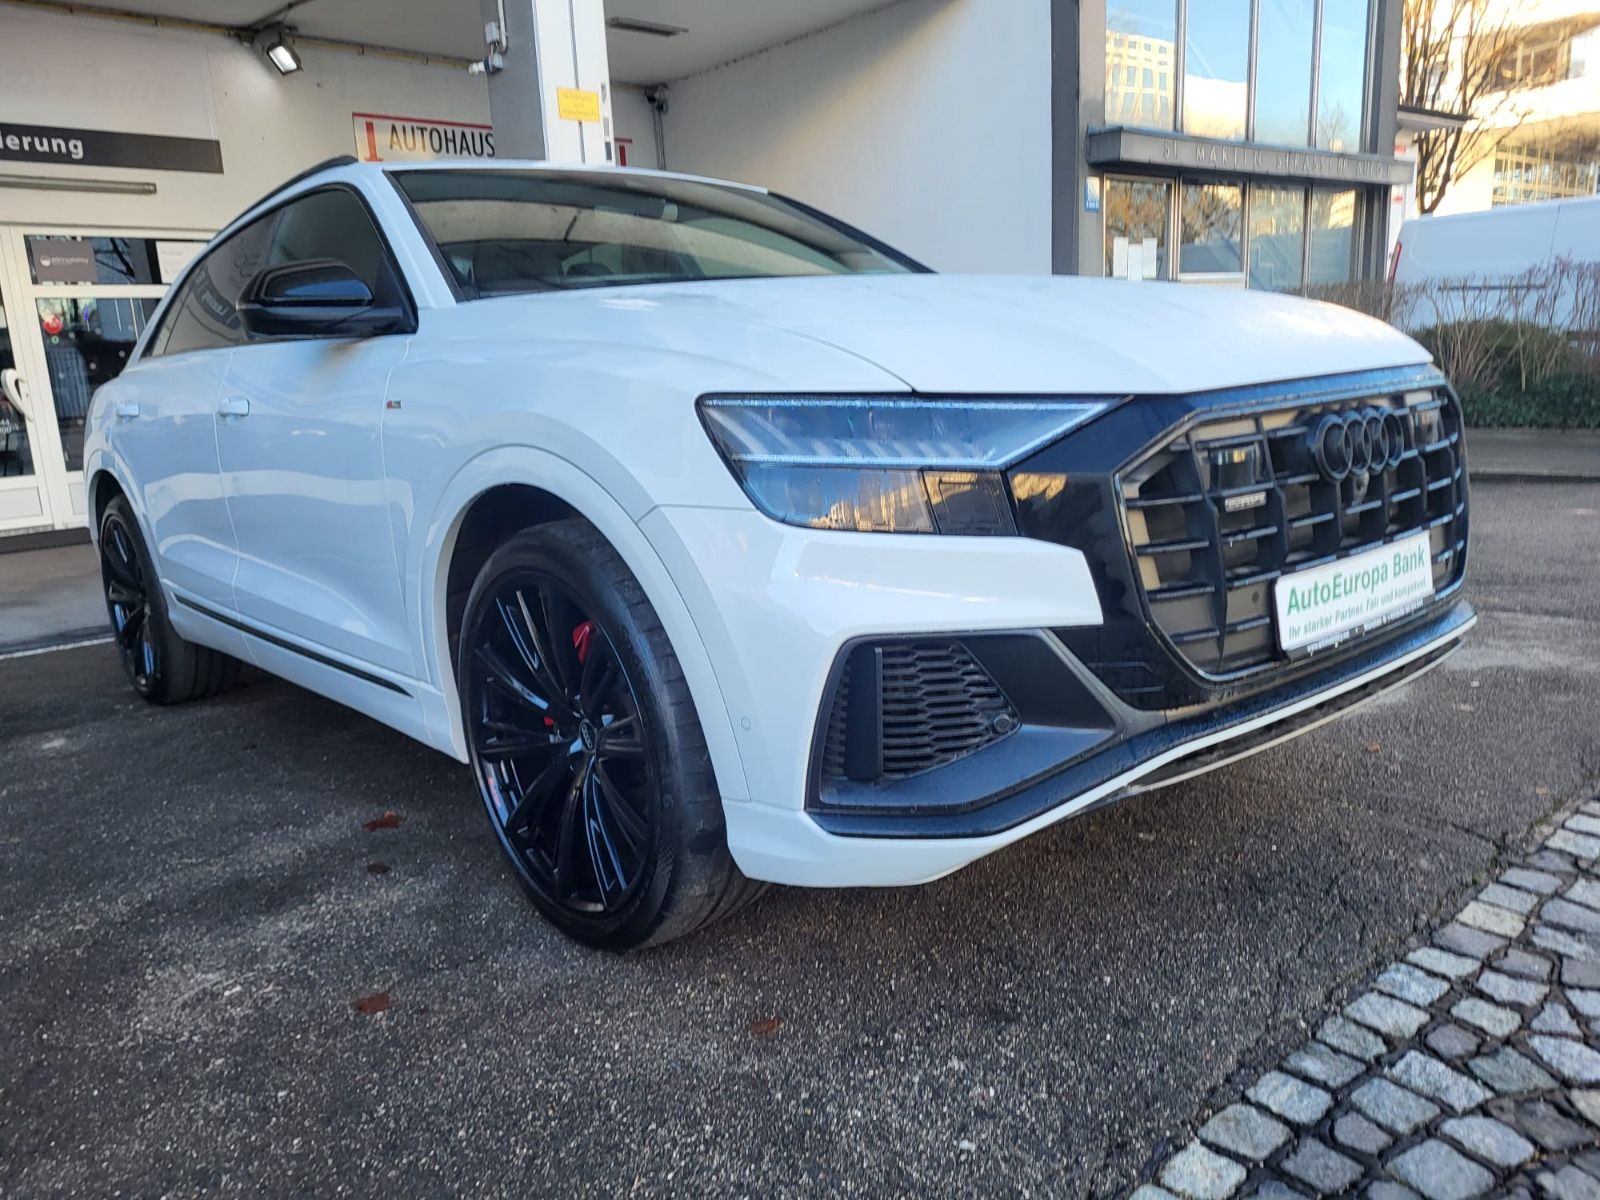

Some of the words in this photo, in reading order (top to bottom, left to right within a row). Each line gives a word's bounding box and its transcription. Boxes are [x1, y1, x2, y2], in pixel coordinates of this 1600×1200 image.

[389, 123, 495, 158] AUTOHAUS
[1287, 563, 1388, 616] AutoEuropa
[1393, 544, 1425, 578] Bank
[1289, 625, 1301, 640] Ihr
[1304, 615, 1333, 635] starker
